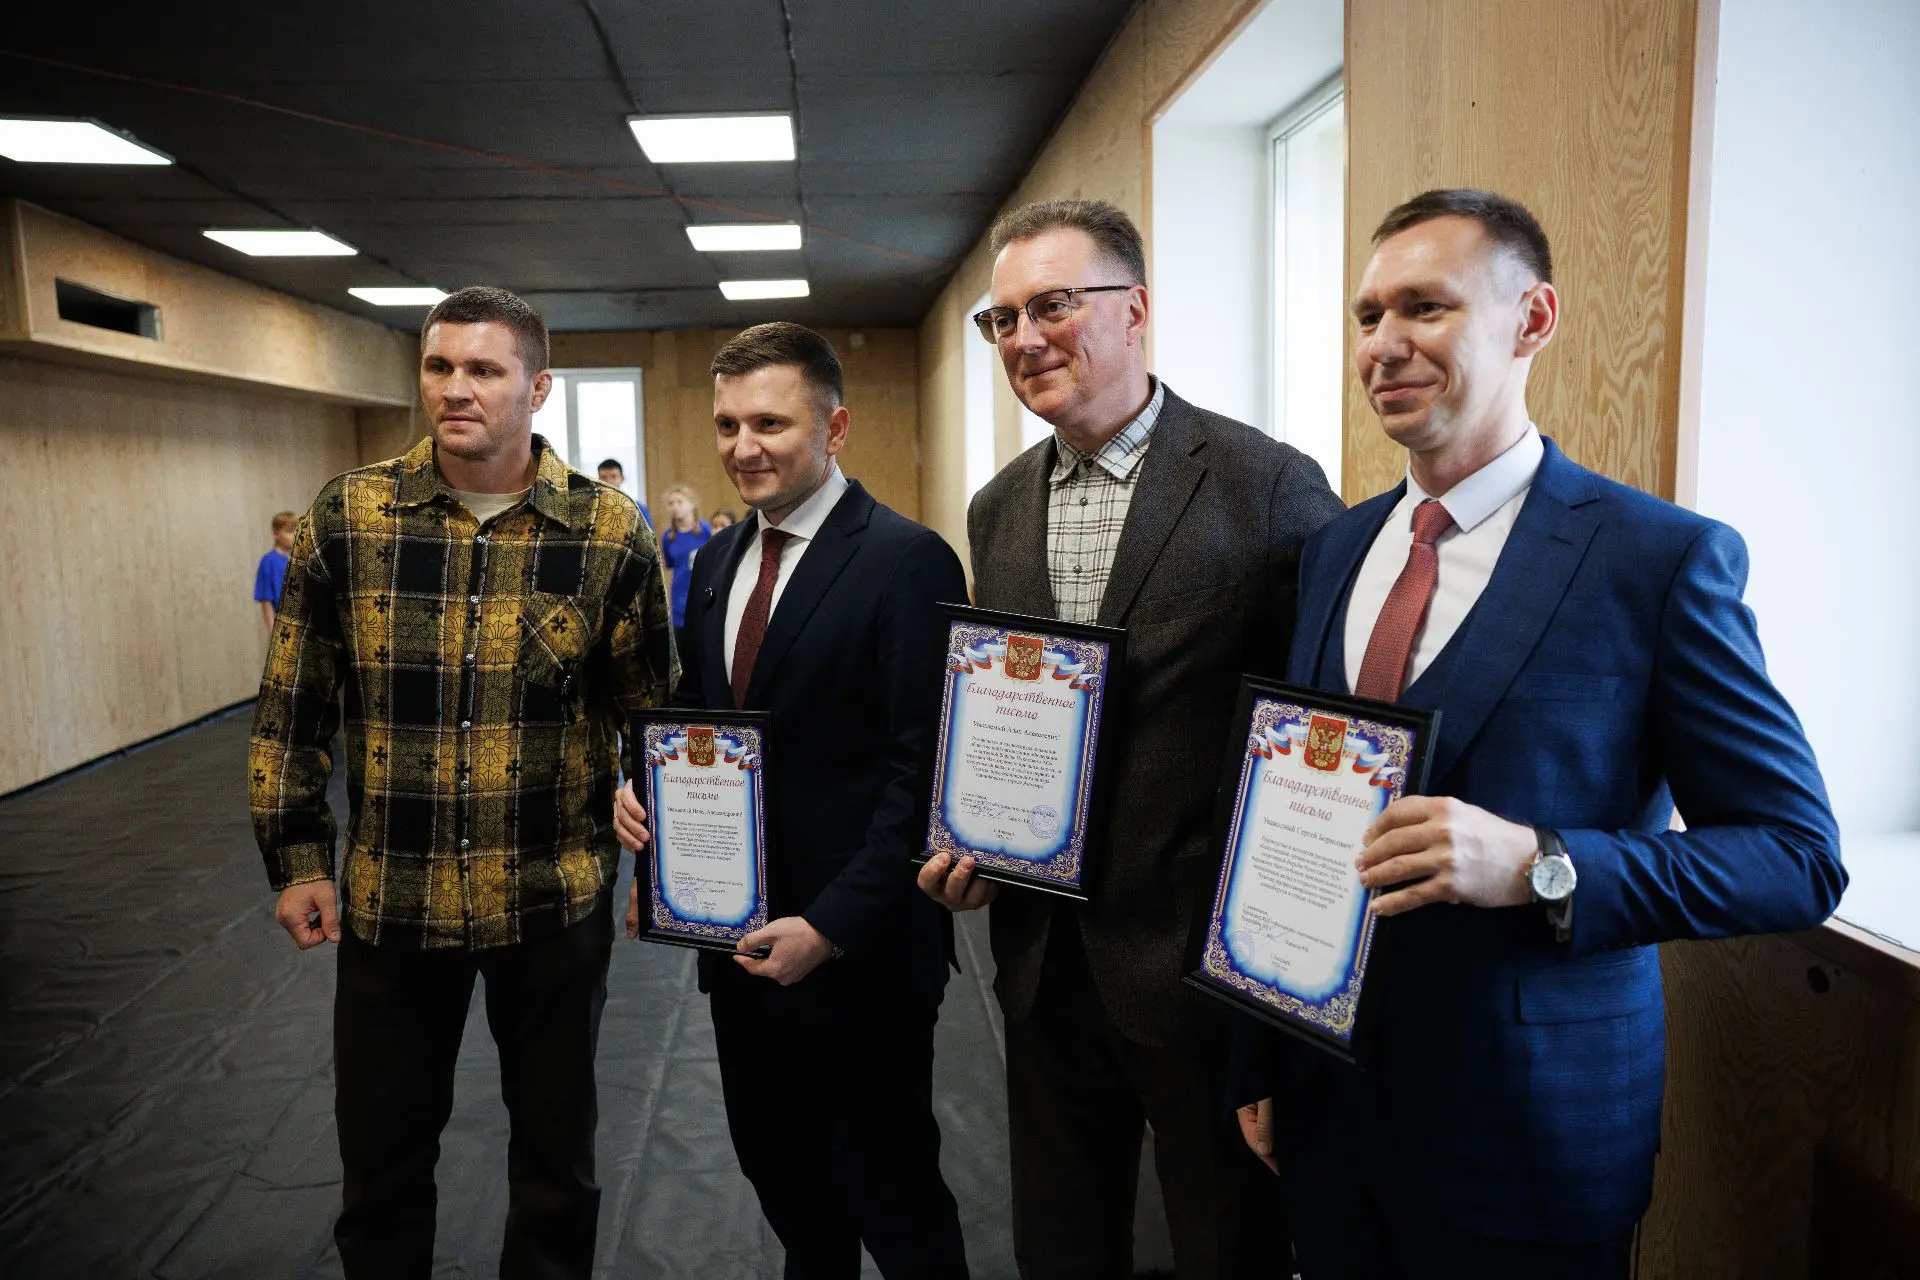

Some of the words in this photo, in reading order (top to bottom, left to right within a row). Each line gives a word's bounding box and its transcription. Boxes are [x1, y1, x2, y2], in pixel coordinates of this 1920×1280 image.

[967, 683, 1076, 709] Благодарственное
[995, 706, 1039, 720] письмо
[663, 773, 745, 788] Благодарственное
[1263, 770, 1373, 811] Благодарственное
[686, 791, 719, 801] письмо
[1288, 801, 1333, 821] письмо
[1264, 816, 1296, 833] Уважаемый
[1297, 827, 1318, 839] Сергей
